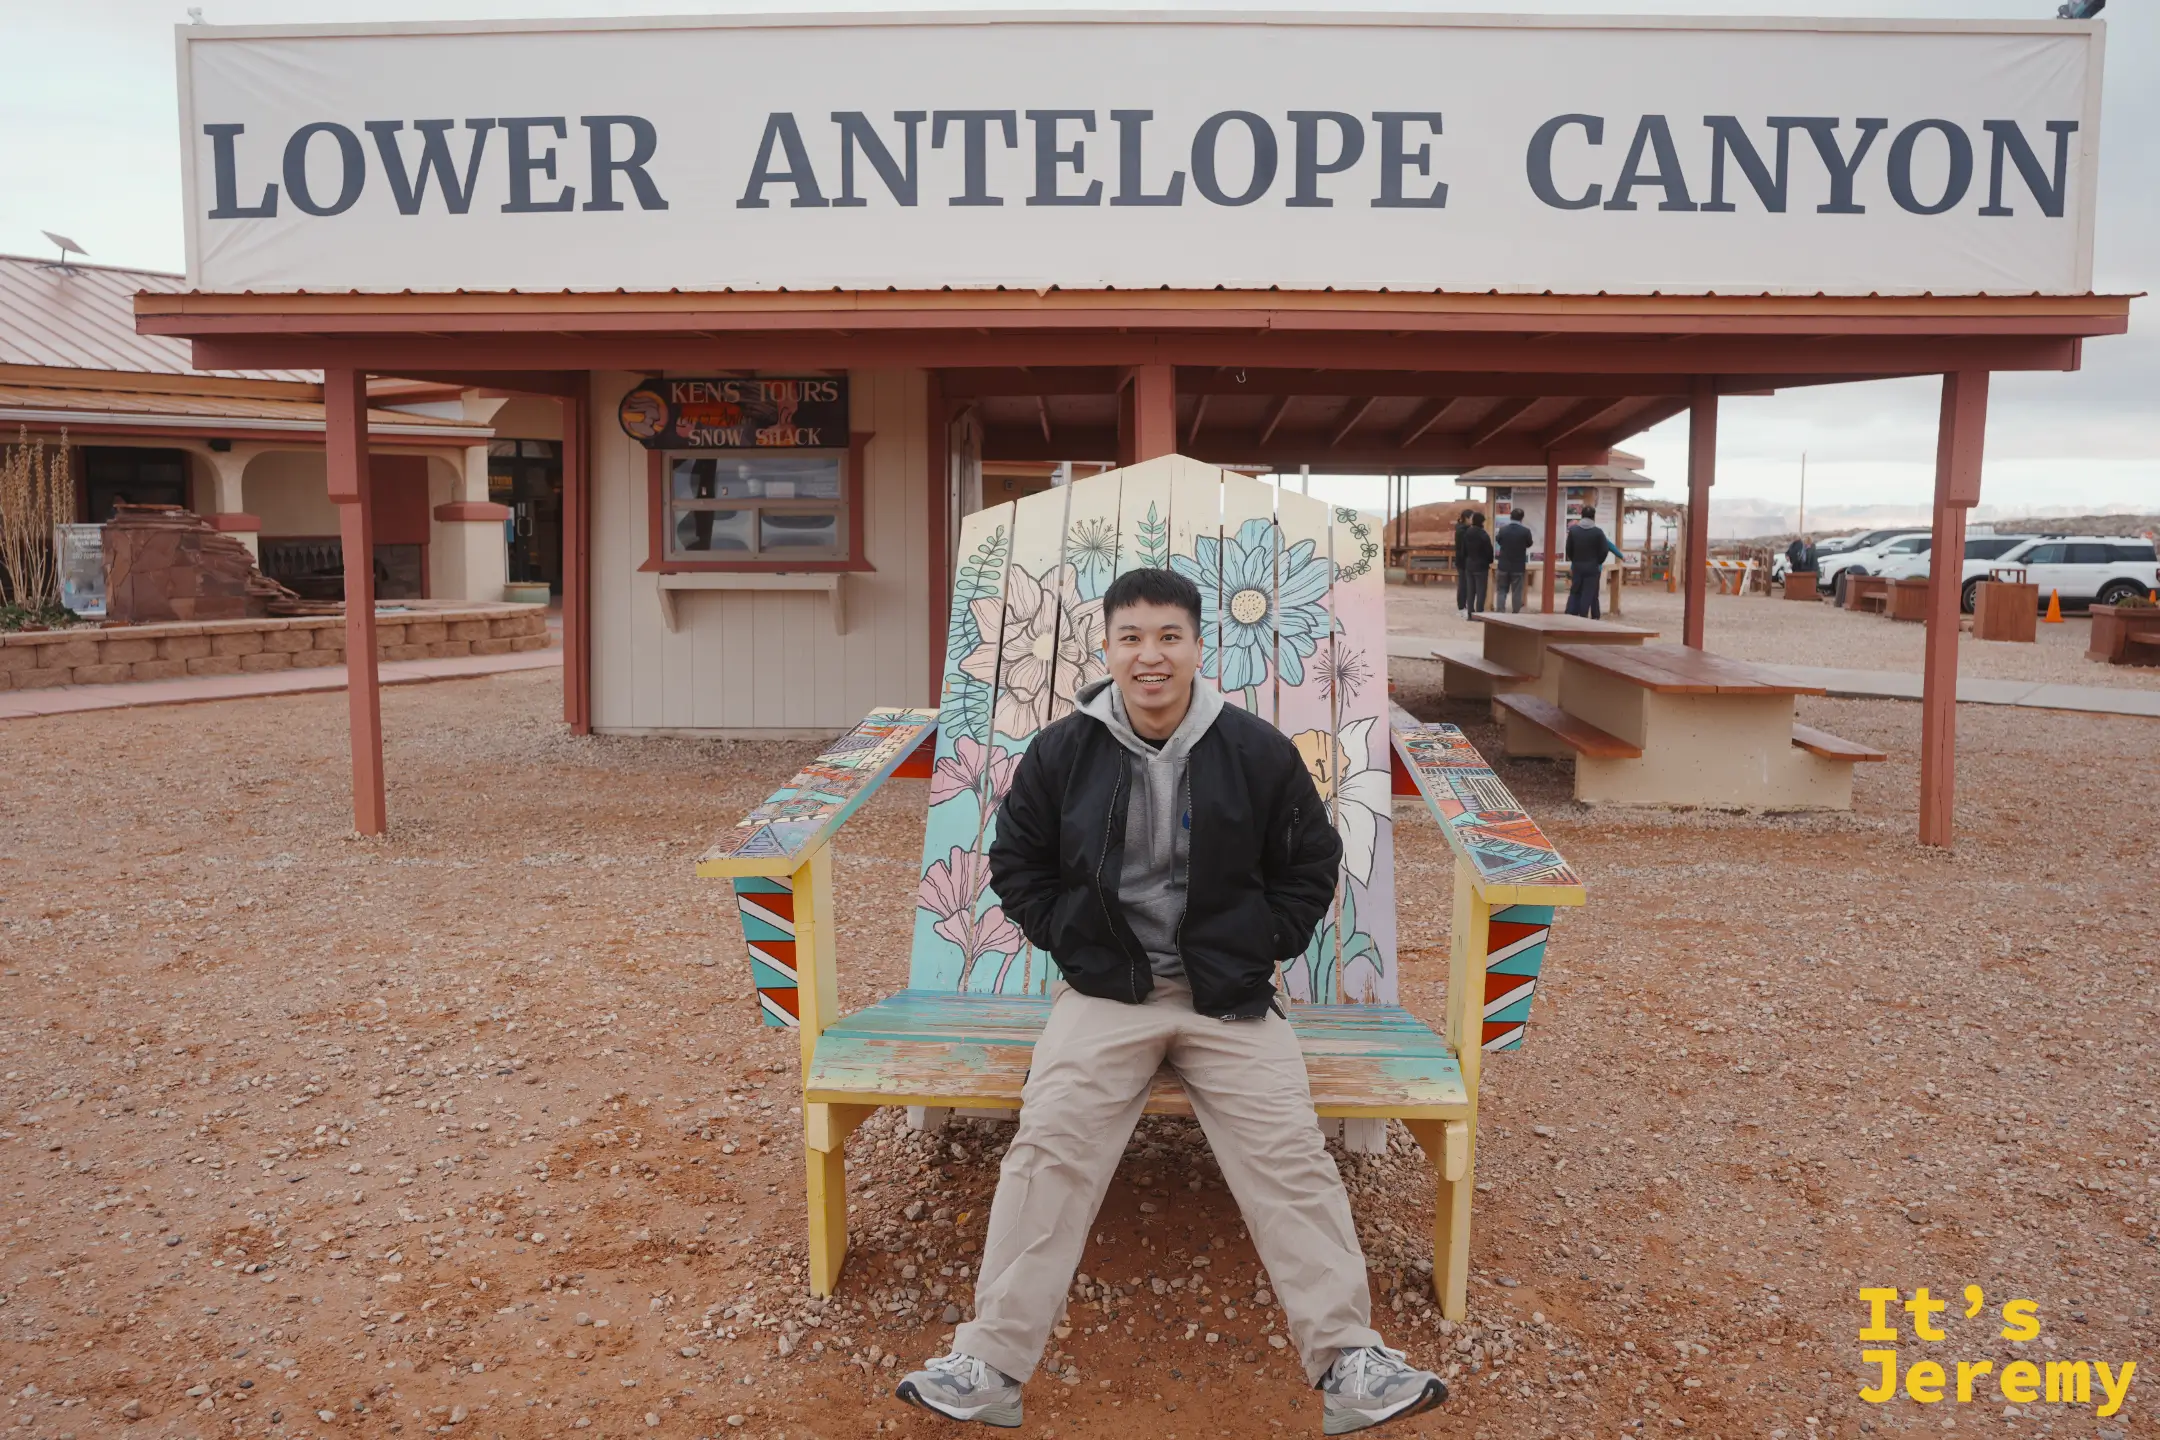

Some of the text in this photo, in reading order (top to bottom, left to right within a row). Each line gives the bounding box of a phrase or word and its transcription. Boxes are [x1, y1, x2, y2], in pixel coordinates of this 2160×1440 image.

[204, 109, 2079, 219] LOWER ANTELOPE CANYON
[758, 381, 838, 402] TOURS
[688, 428, 822, 447] SNOW SHACK
